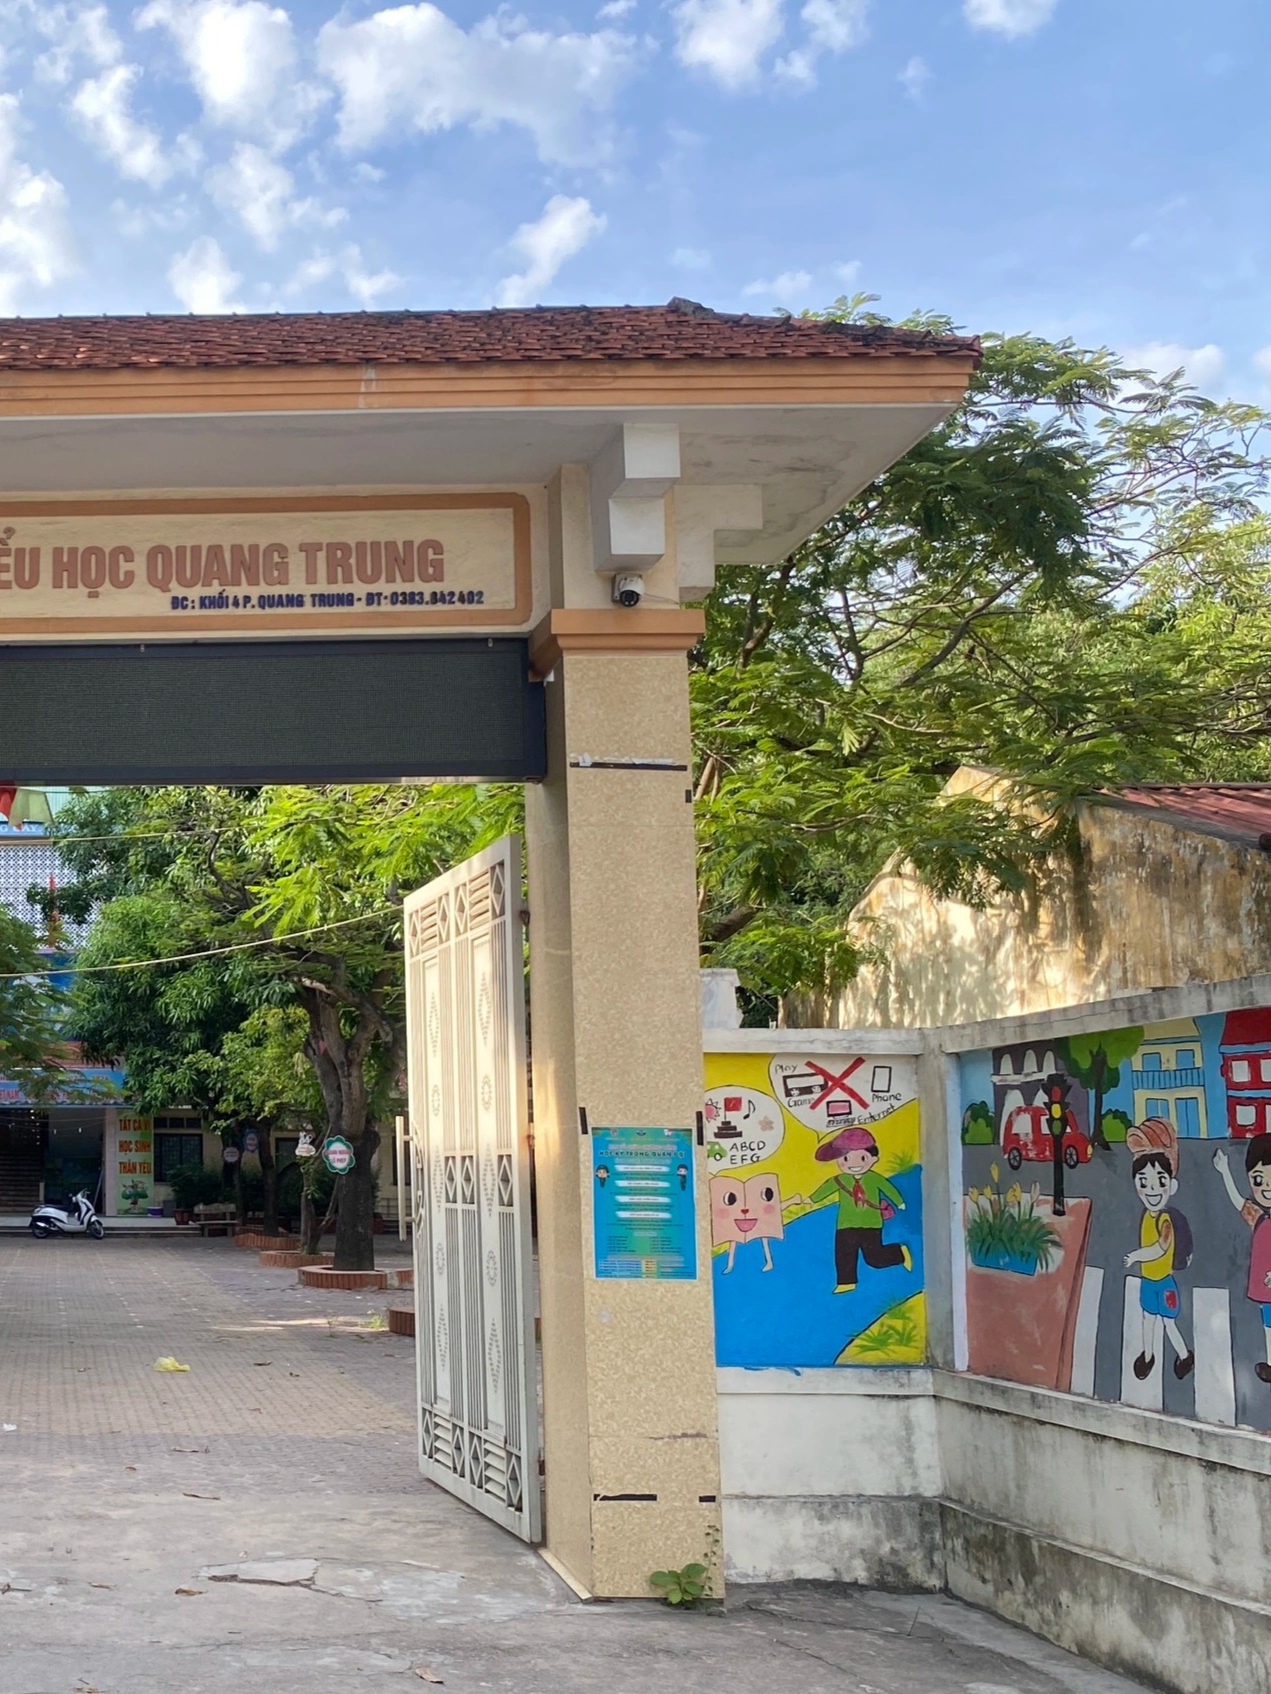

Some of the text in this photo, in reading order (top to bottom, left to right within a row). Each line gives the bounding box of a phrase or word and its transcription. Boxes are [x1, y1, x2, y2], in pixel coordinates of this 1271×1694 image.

[52, 545, 135, 599] HỌC
[146, 542, 290, 593] QUANG
[299, 539, 444, 585] TRUNG
[199, 589, 229, 610] KHỐI
[258, 593, 305, 610] QUANG
[310, 592, 355, 608] TRUNG
[774, 1063, 798, 1075] Play
[872, 1092, 902, 1103] Phone
[118, 1140, 133, 1155] HỌC
